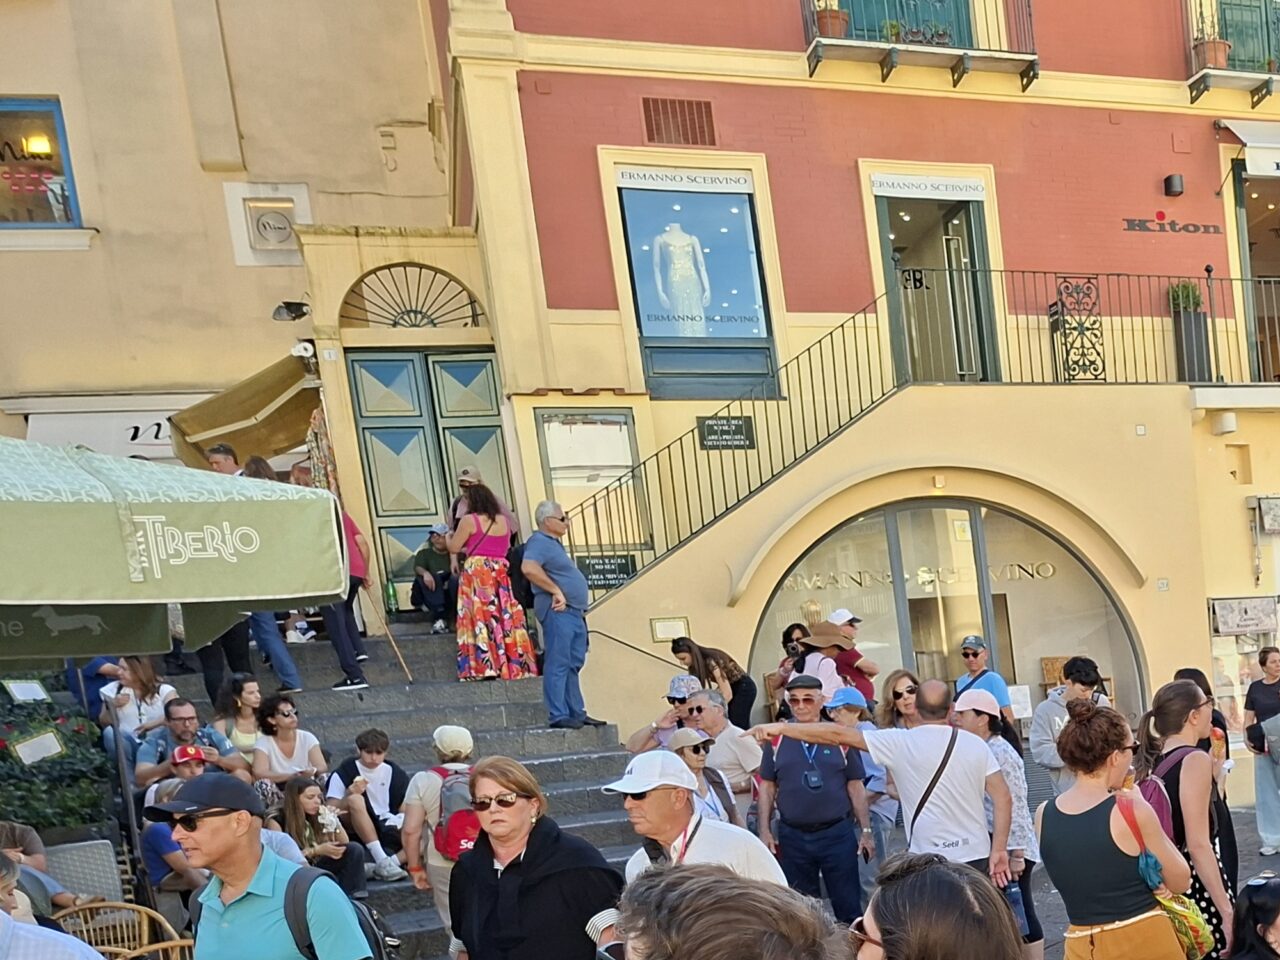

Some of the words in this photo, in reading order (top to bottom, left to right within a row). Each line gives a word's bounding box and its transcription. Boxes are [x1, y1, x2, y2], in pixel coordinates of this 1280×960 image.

[620, 170, 684, 183] ERMANNO
[686, 174, 748, 186] SCERVINO
[871, 180, 928, 191] ERMANNO
[929, 182, 985, 193] SCERVINO
[1122, 210, 1224, 235] Kiton
[646, 314, 703, 323] ERMANNO
[705, 315, 760, 324] SCERVINO
